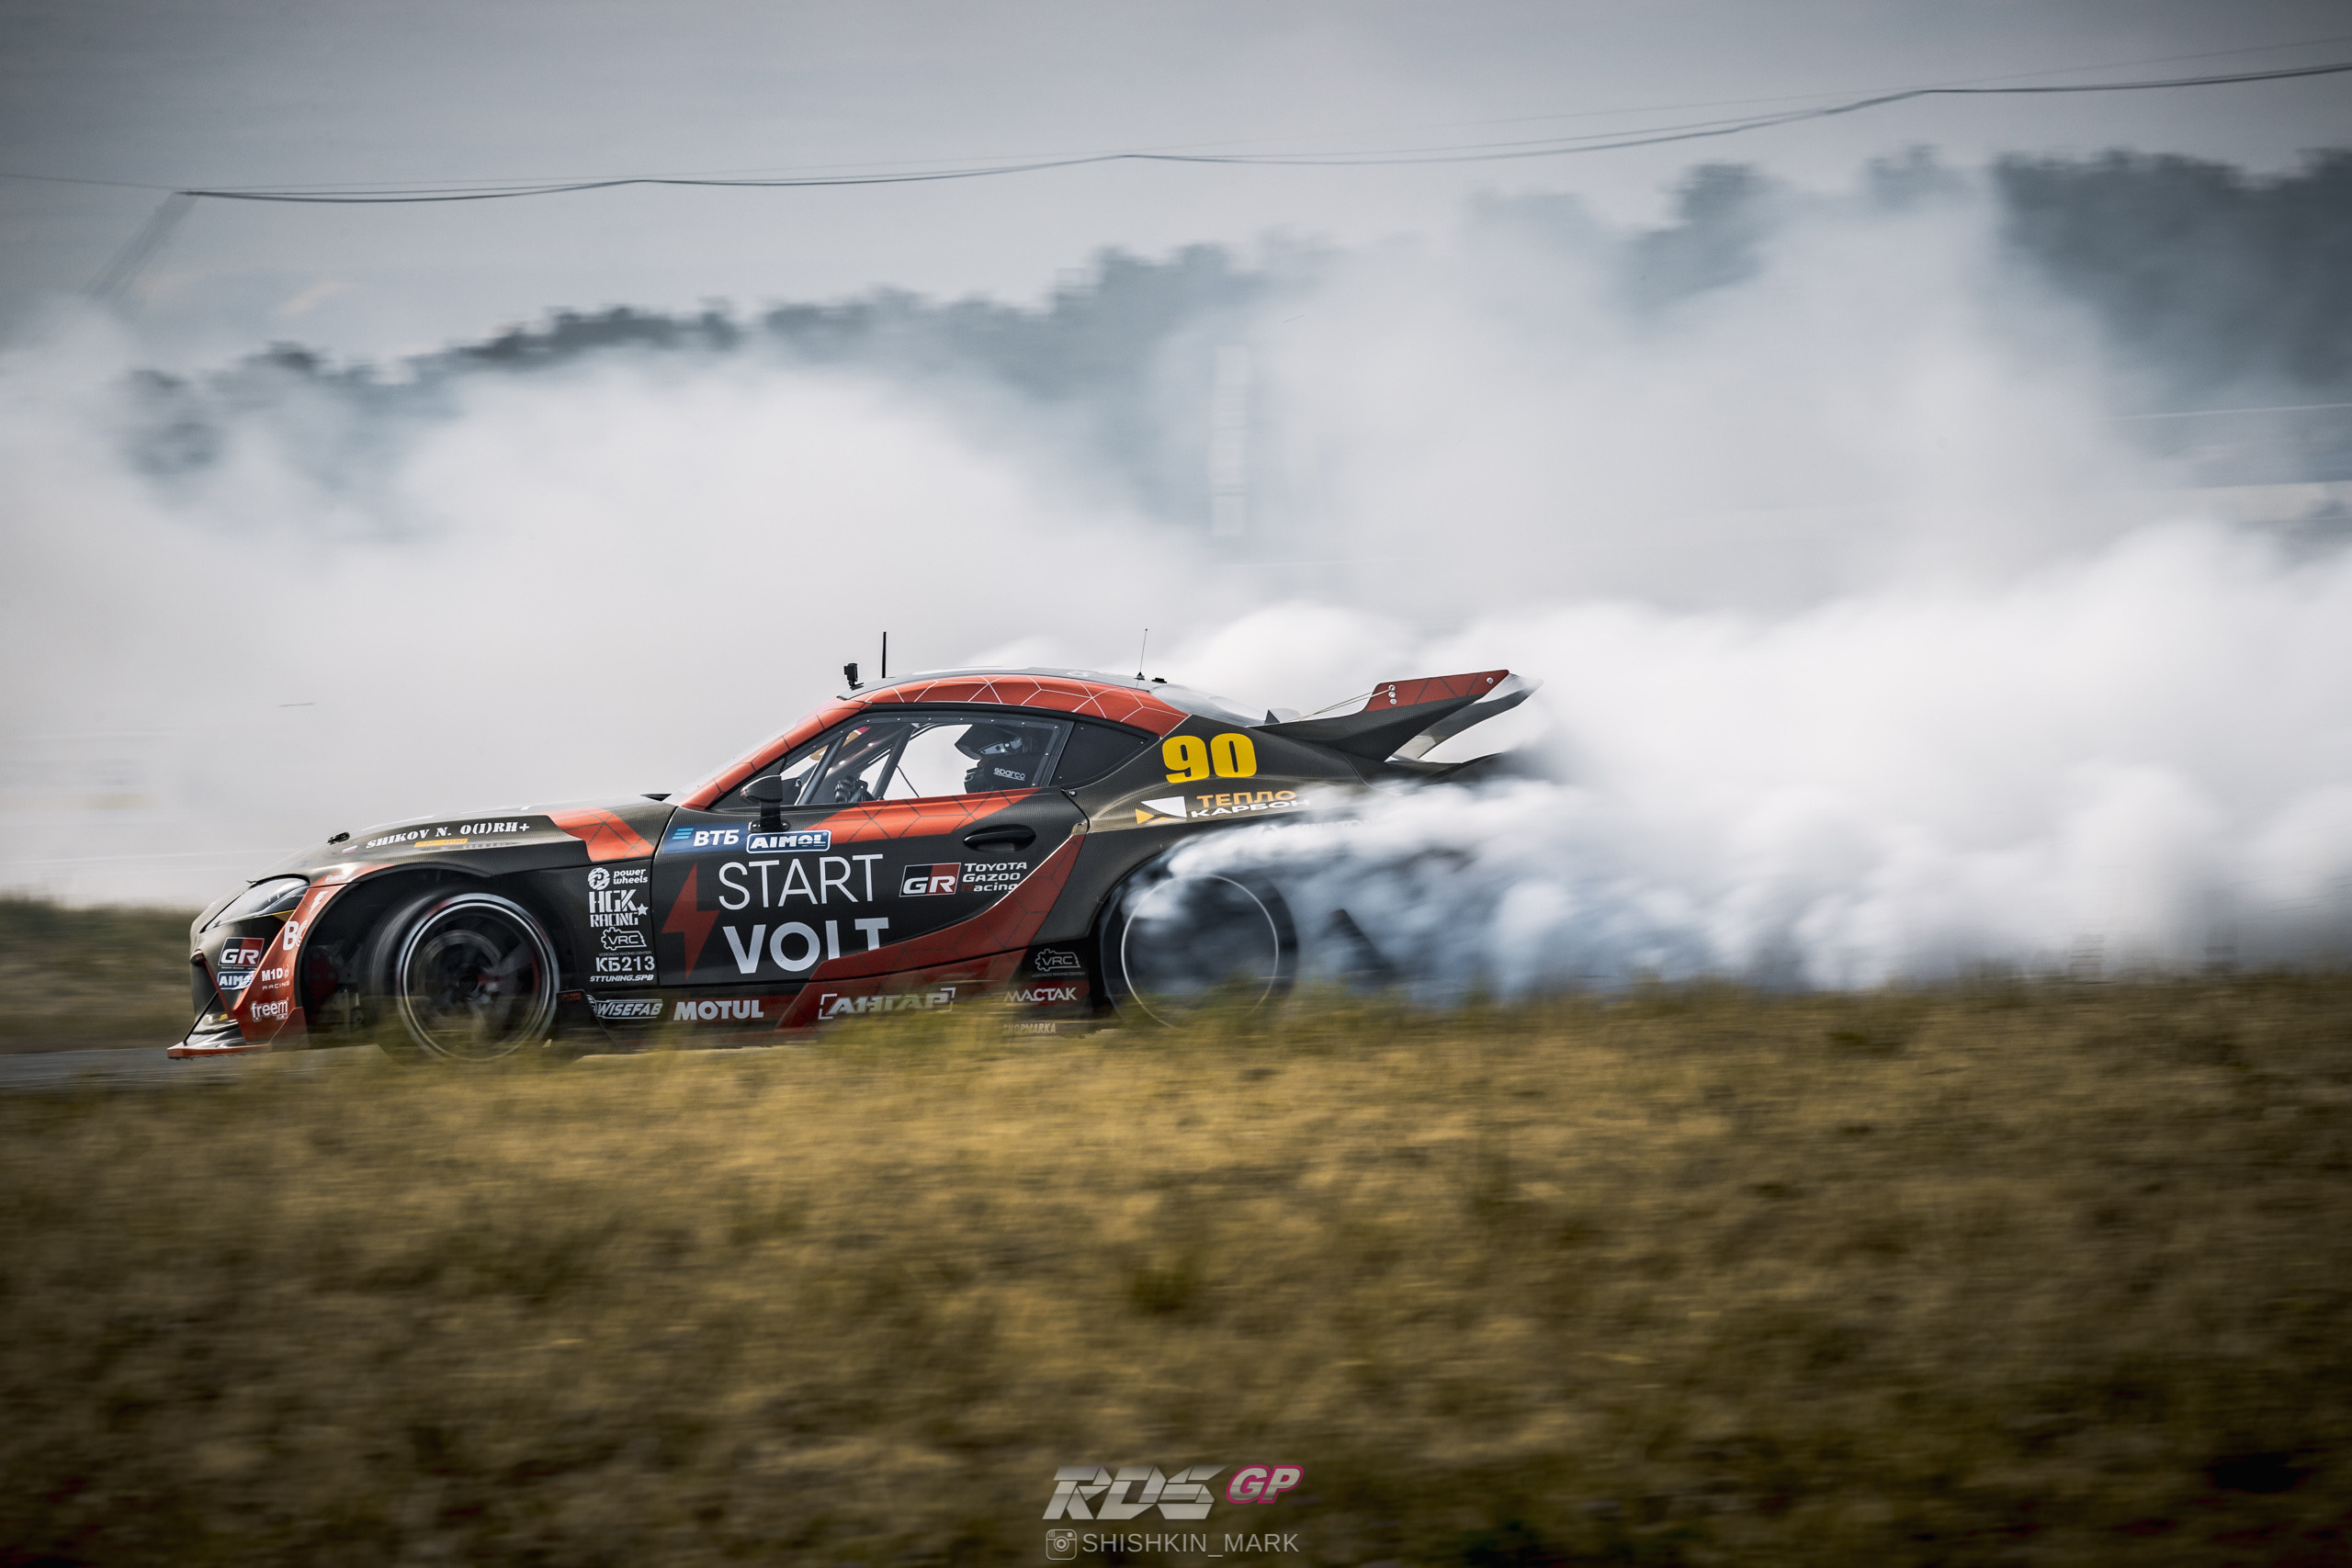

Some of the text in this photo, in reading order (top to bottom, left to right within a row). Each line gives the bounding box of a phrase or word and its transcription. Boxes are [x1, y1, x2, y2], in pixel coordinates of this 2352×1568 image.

[1161, 733, 1257, 784] 90
[993, 767, 1025, 780] sparco
[1196, 790, 1296, 808] ТЕПЛО
[1191, 799, 1311, 818] КАРБОН
[366, 829, 430, 849] SHIKOV
[435, 826, 451, 838] N.
[693, 829, 741, 847] ВТБ
[750, 833, 827, 850] AIMOL
[613, 869, 647, 878] power
[965, 862, 1027, 873] TOYOTA
[613, 876, 648, 885] wheels
[718, 854, 884, 910] START
[902, 875, 956, 895] GR
[962, 873, 1021, 883] GAZOO
[589, 889, 637, 913] HGK
[590, 912, 639, 928] RACING
[607, 935, 639, 944] VRC
[220, 948, 259, 964] GR
[1042, 956, 1073, 965] VRC
[262, 979, 290, 990] RACING
[596, 1003, 663, 1016] WISEFAB
[673, 999, 764, 1021] MOTUL
